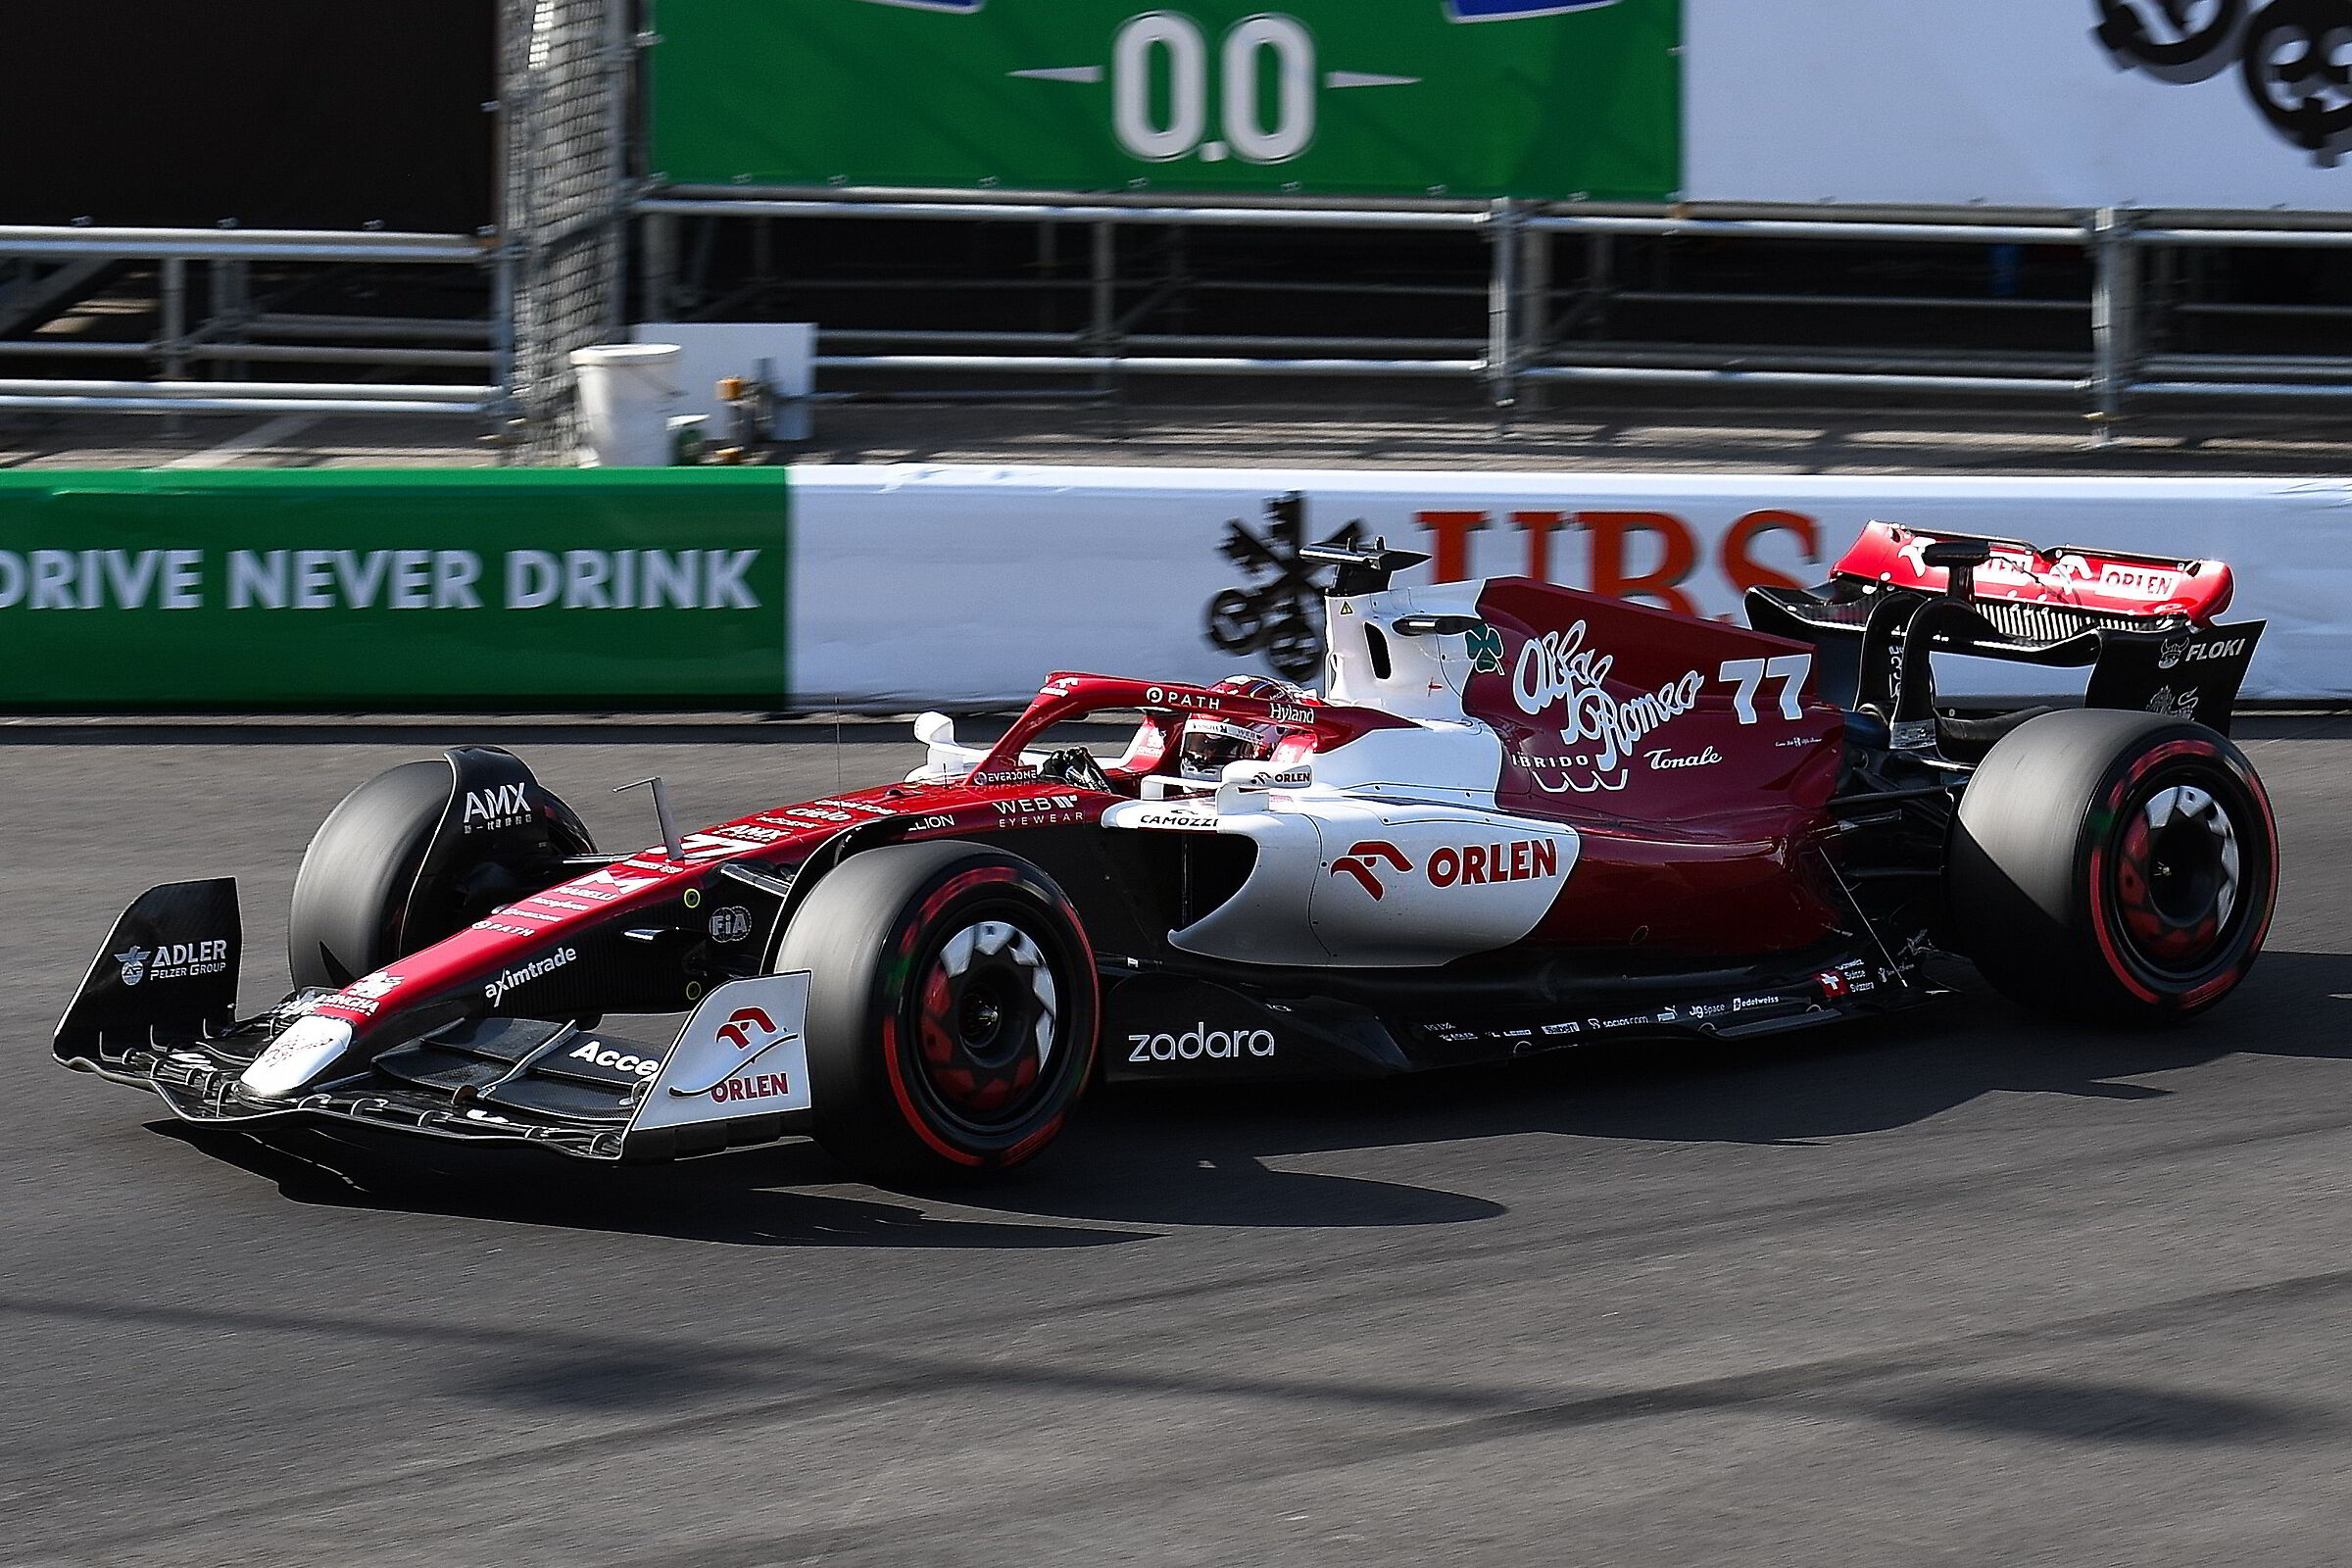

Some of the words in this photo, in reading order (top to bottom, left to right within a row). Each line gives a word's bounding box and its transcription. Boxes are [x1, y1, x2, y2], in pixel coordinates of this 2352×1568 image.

[1112, 10, 1317, 164] 0.0
[226, 549, 484, 611] NEVER
[505, 549, 762, 611] DRINK
[2184, 637, 2246, 662] FLOKI
[1512, 618, 1614, 745] Alfa
[1718, 653, 1813, 725] 77
[1167, 693, 1220, 710] PATH
[1268, 702, 1315, 724] Hyland
[1570, 669, 1705, 772] Romeo
[1642, 745, 1724, 770] Tonale
[1273, 771, 1311, 783] ORLEN
[463, 782, 532, 823] AMX
[992, 797, 1052, 814] WEB
[907, 813, 956, 831] LION
[999, 811, 1084, 828] EYEWEAR
[1140, 814, 1218, 828] CAMOZZI
[1426, 838, 1558, 889] ORLEN
[151, 939, 227, 968] ADLER
[149, 966, 187, 981] PELZER
[189, 961, 226, 976] GROUP
[484, 946, 577, 1007] aximtrade
[1128, 1021, 1275, 1062] zadara
[568, 1040, 660, 1076] Acce
[710, 1072, 789, 1103] ORLEN
